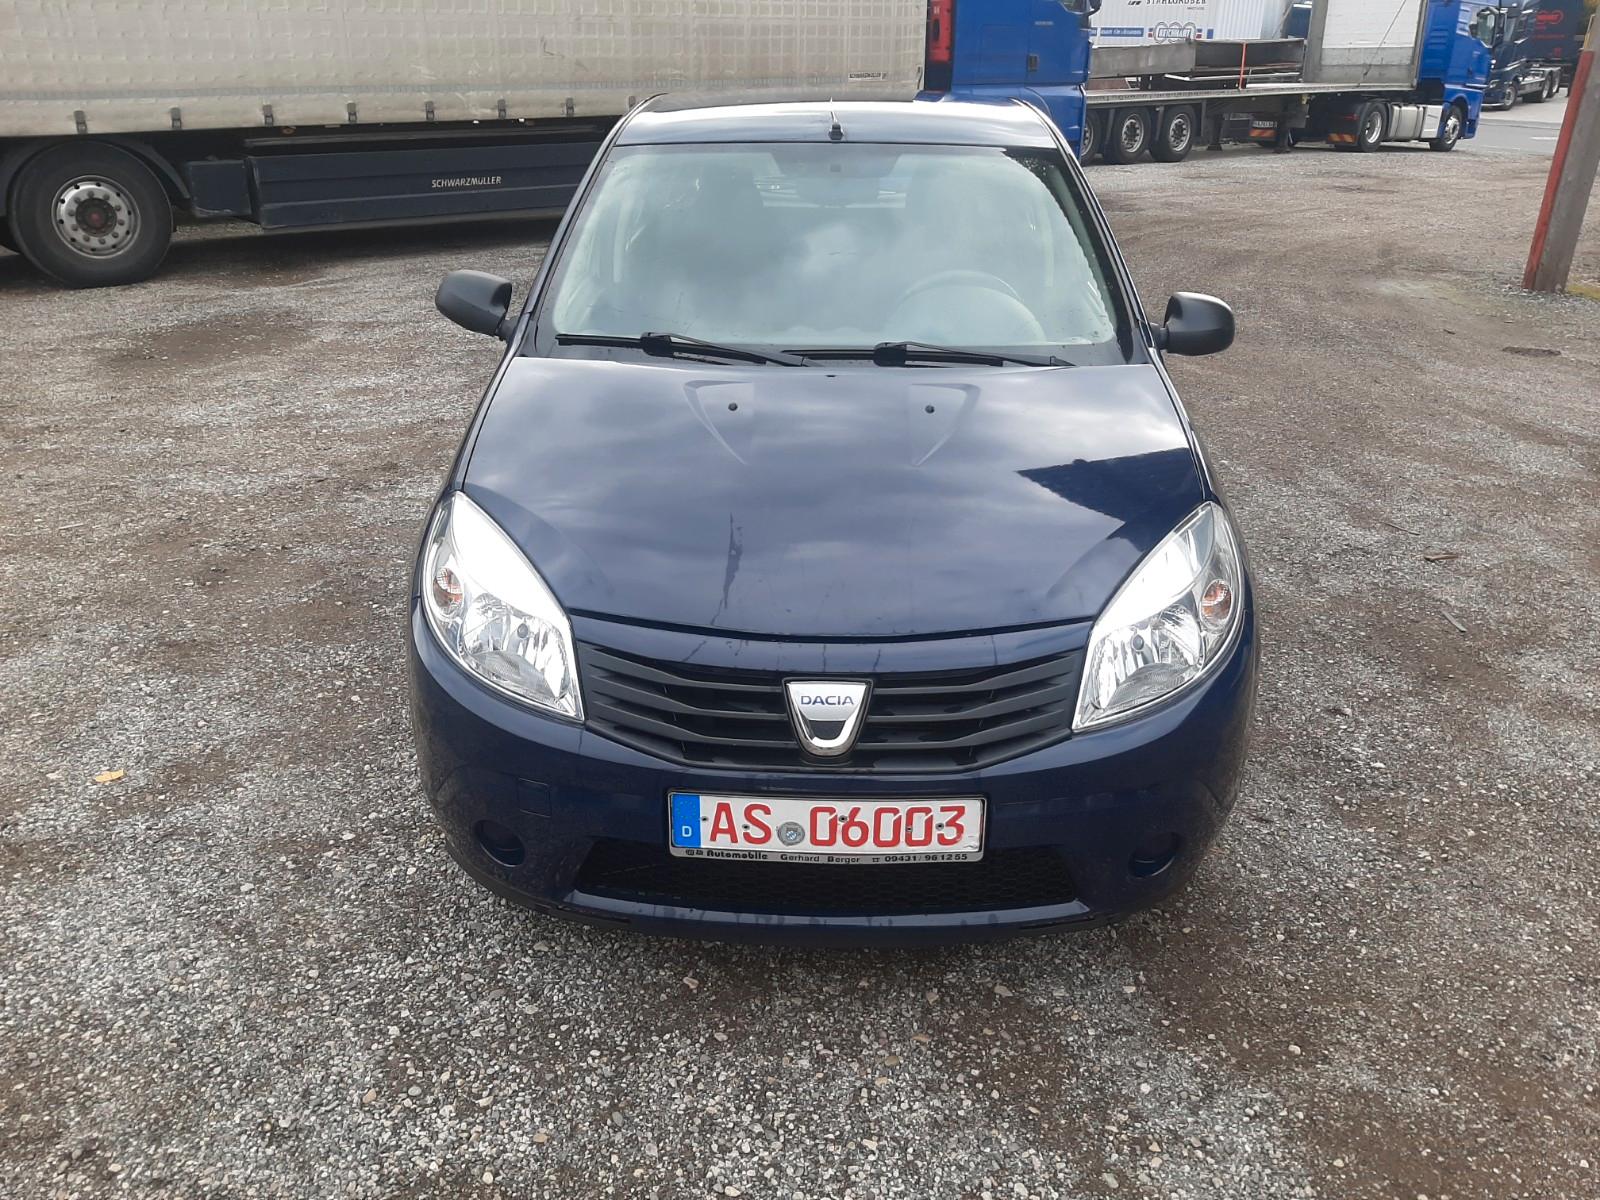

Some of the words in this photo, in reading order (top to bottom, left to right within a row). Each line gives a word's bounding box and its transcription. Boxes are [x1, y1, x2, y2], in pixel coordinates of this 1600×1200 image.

[800, 695, 854, 706] DACIA
[682, 825, 692, 837] D
[709, 802, 771, 845] AS
[809, 805, 965, 848] 06003
[707, 849, 769, 860] Automobile
[780, 853, 820, 862] Gerhard
